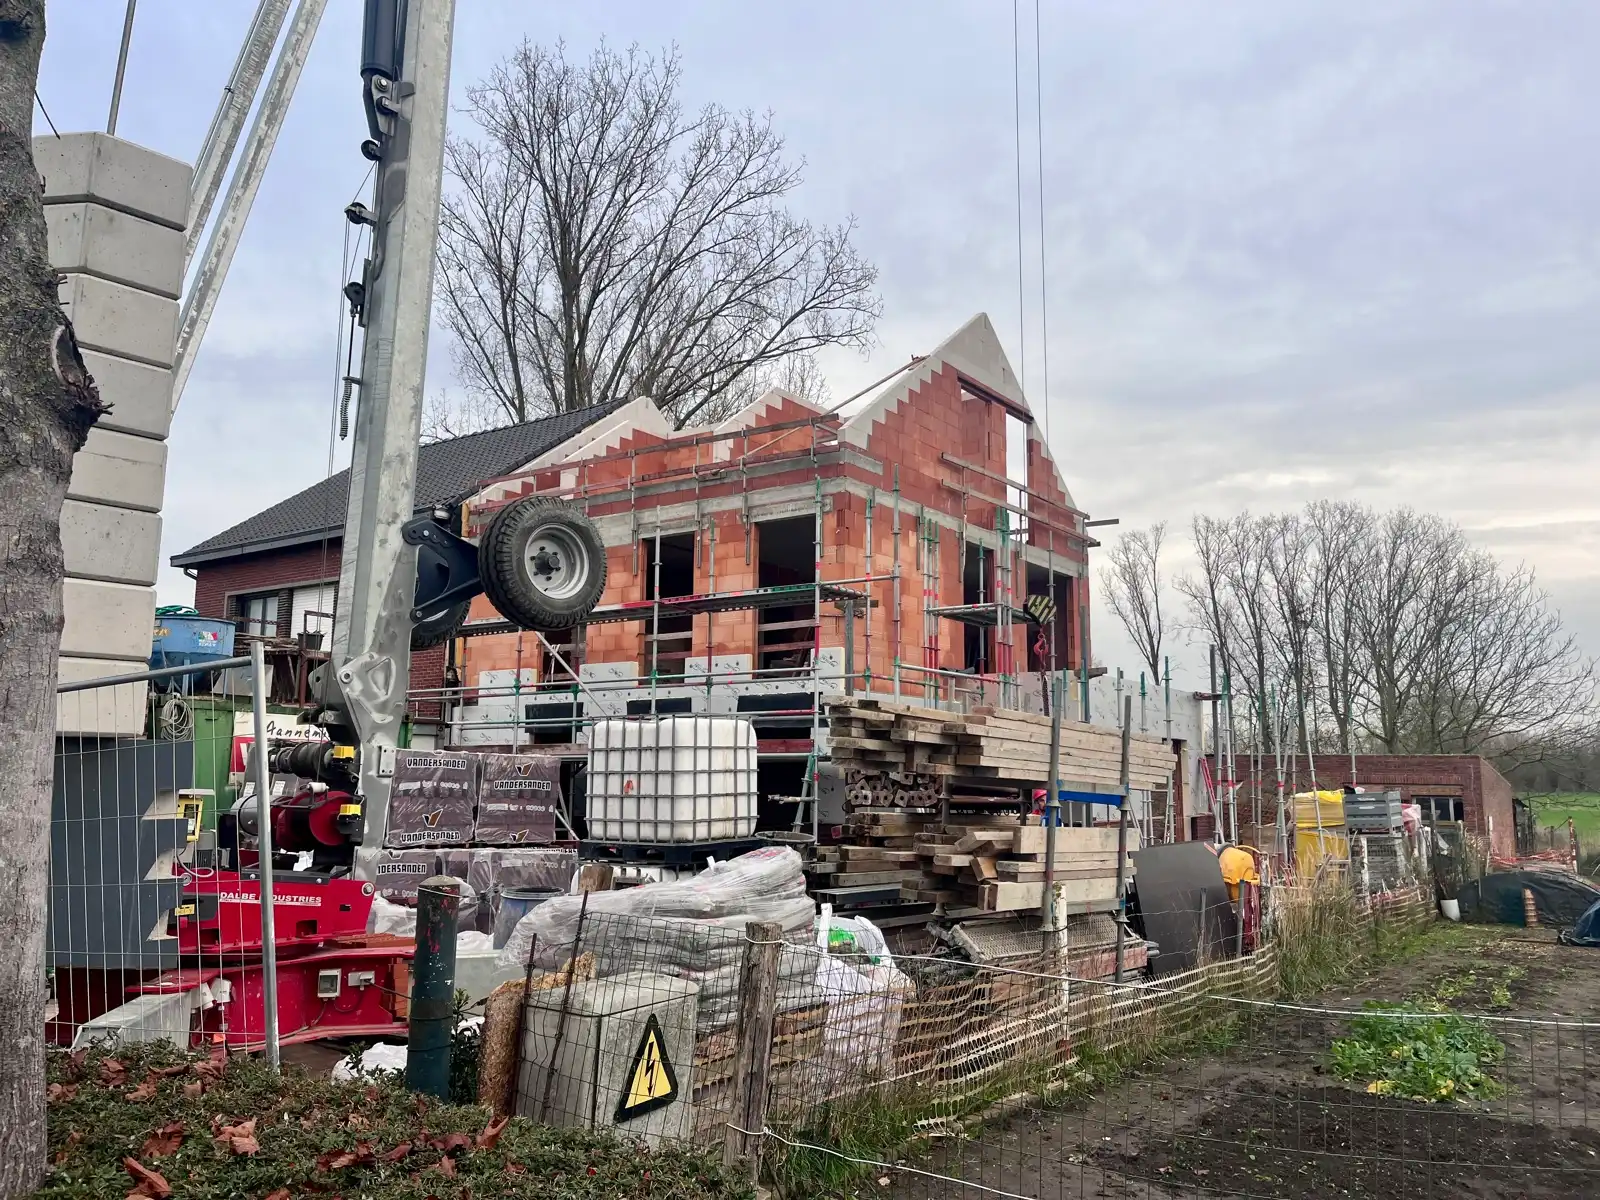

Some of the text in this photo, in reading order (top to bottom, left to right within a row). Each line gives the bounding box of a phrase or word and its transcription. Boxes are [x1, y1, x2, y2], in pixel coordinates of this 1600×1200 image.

[407, 758, 466, 769] VANDERSANDEN
[494, 780, 551, 790] VANDERSANDEN
[401, 831, 460, 842] VANDERSANDEN
[220, 892, 256, 900] DALBE
[259, 894, 322, 903] DUSTRIES
